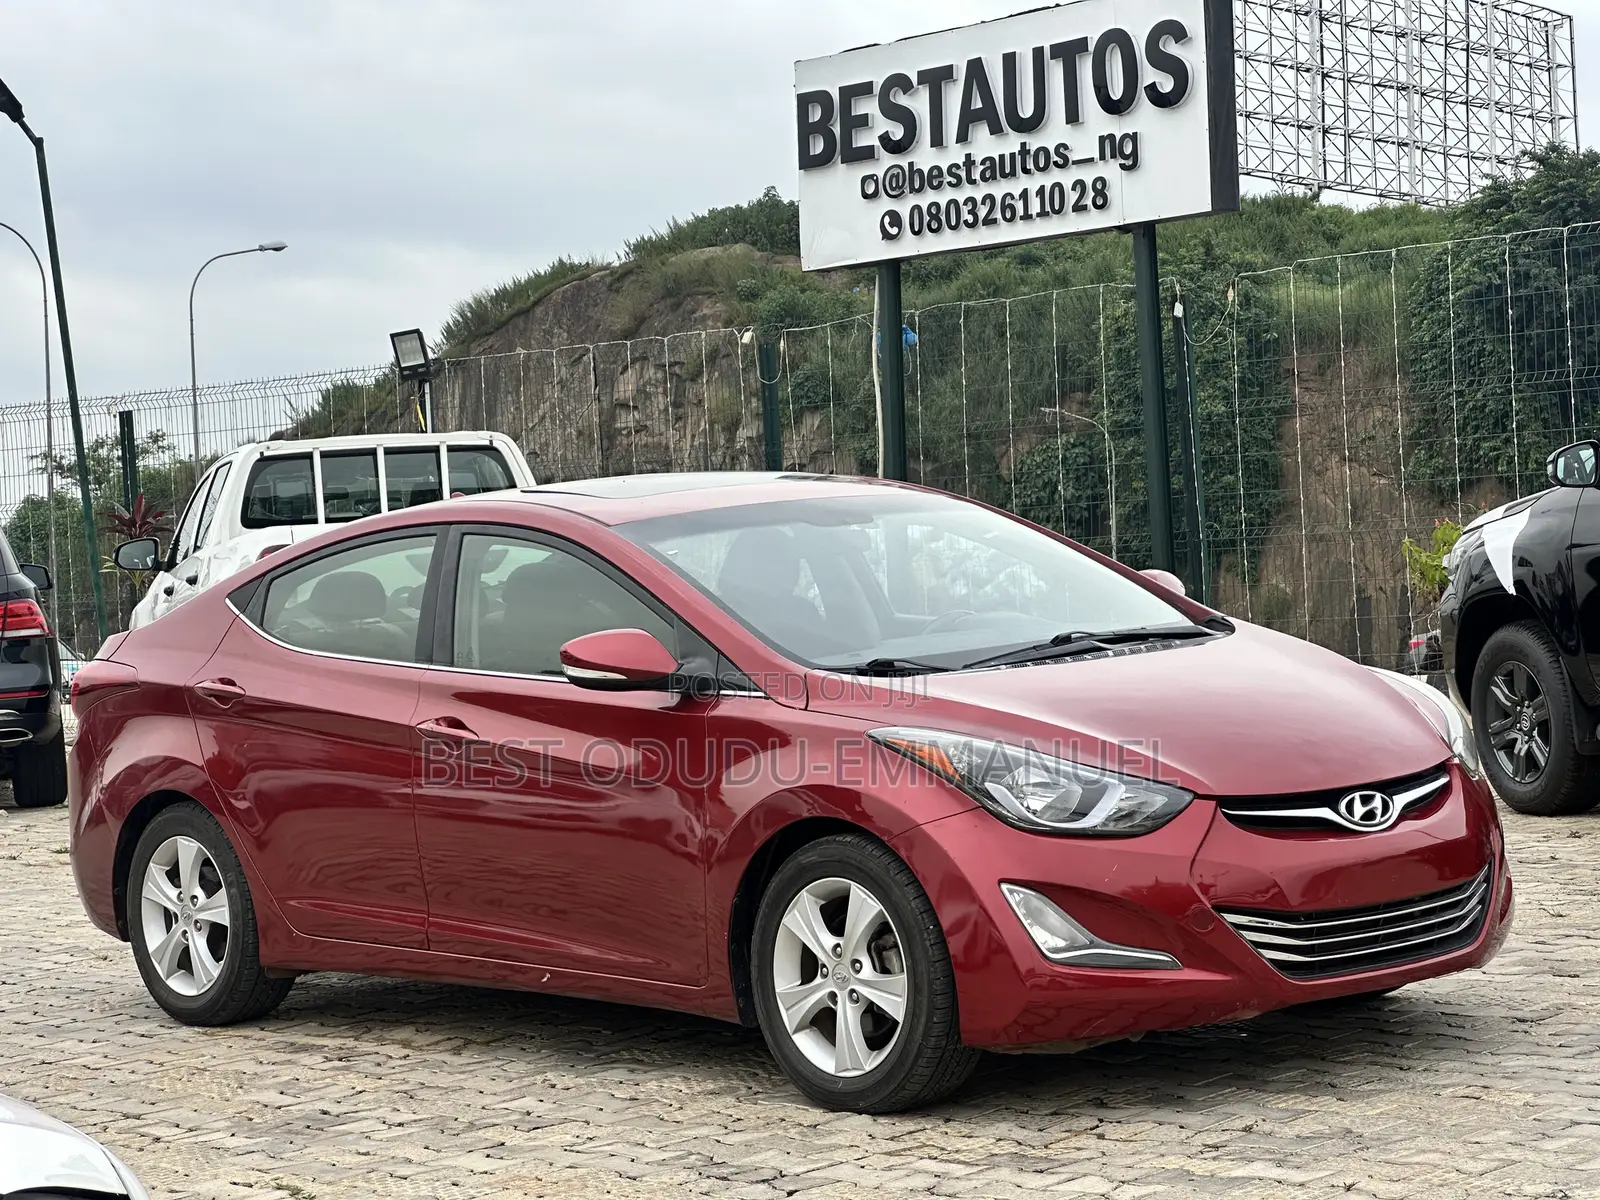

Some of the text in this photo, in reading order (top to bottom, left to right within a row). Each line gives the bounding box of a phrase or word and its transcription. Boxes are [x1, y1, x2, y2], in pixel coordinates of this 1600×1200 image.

[797, 19, 1192, 170] BESTAUTOS
[882, 131, 1139, 199] @bestautos_ng
[909, 176, 1110, 236] 08032611028
